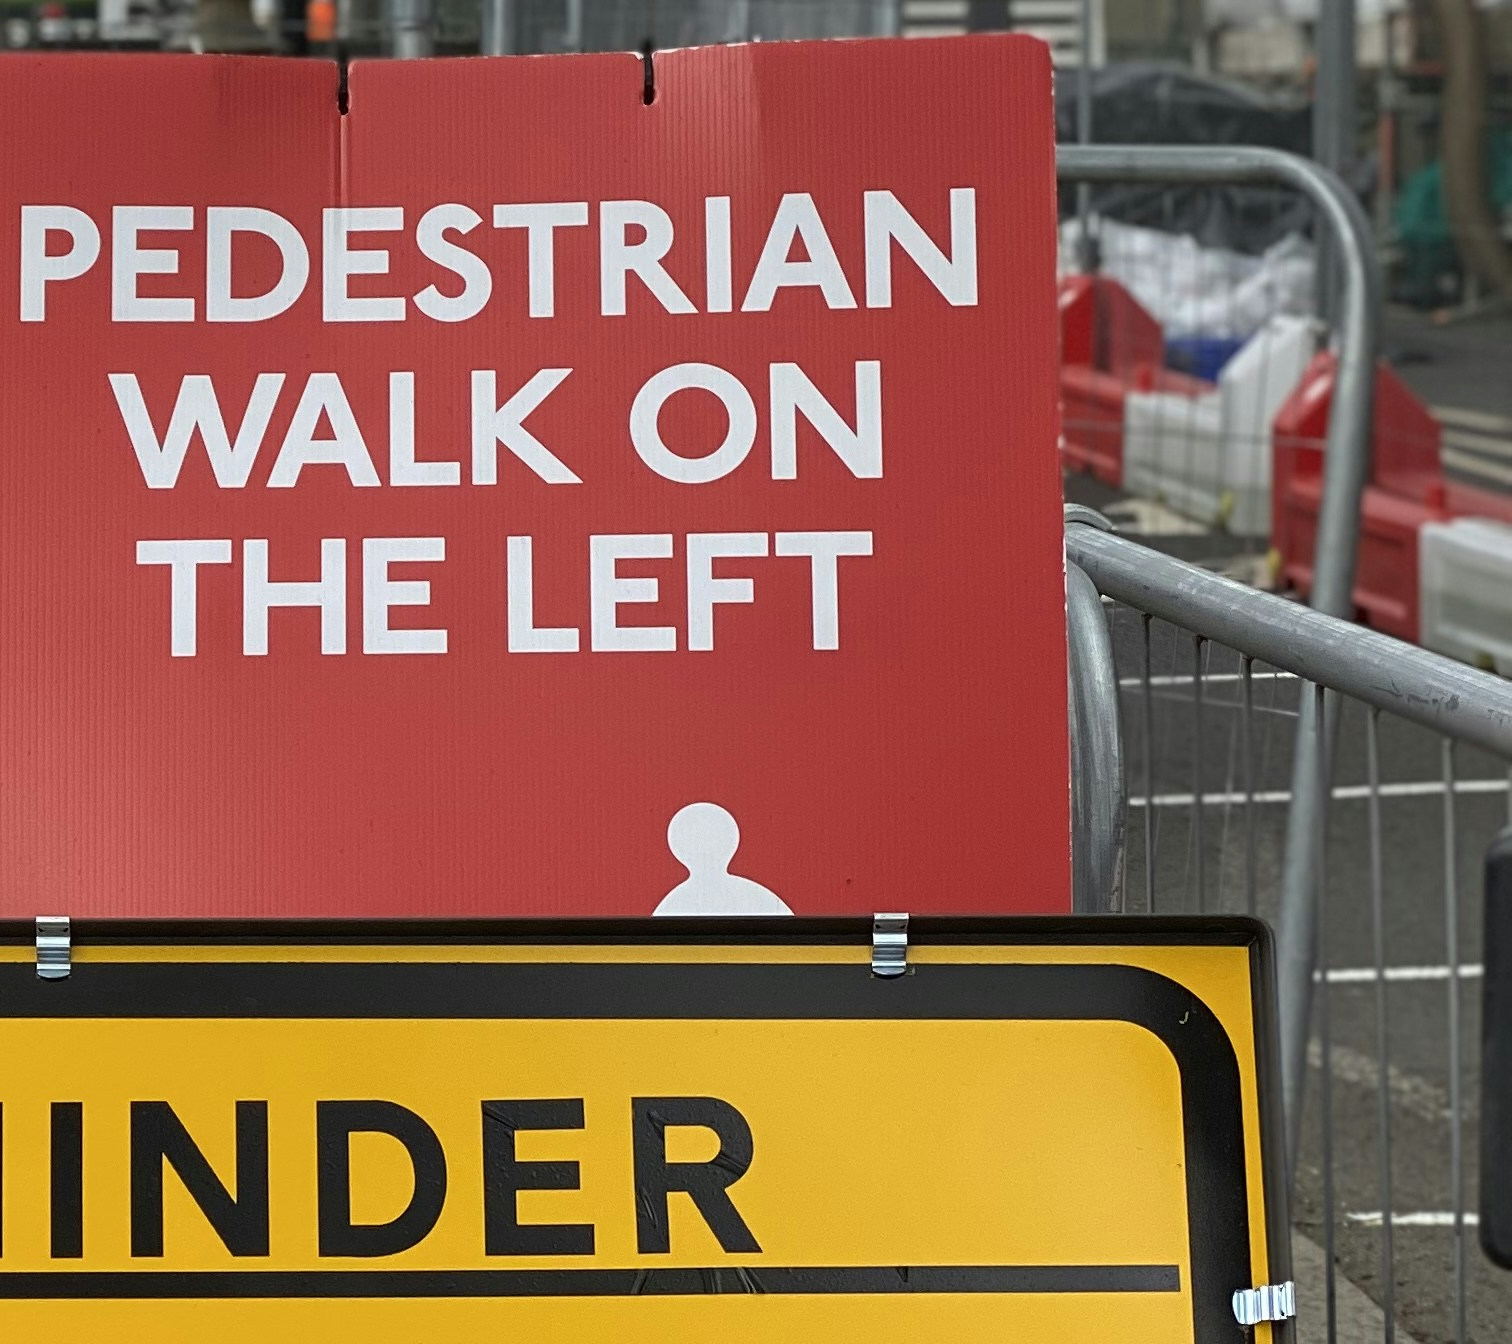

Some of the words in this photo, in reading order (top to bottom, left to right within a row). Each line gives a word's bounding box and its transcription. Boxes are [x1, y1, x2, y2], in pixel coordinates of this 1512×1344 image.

[18, 188, 979, 323] PEDESTRIAN
[108, 368, 585, 490] WALK
[629, 361, 884, 485] ON
[135, 536, 449, 657] THE
[506, 530, 875, 653] LEFT
